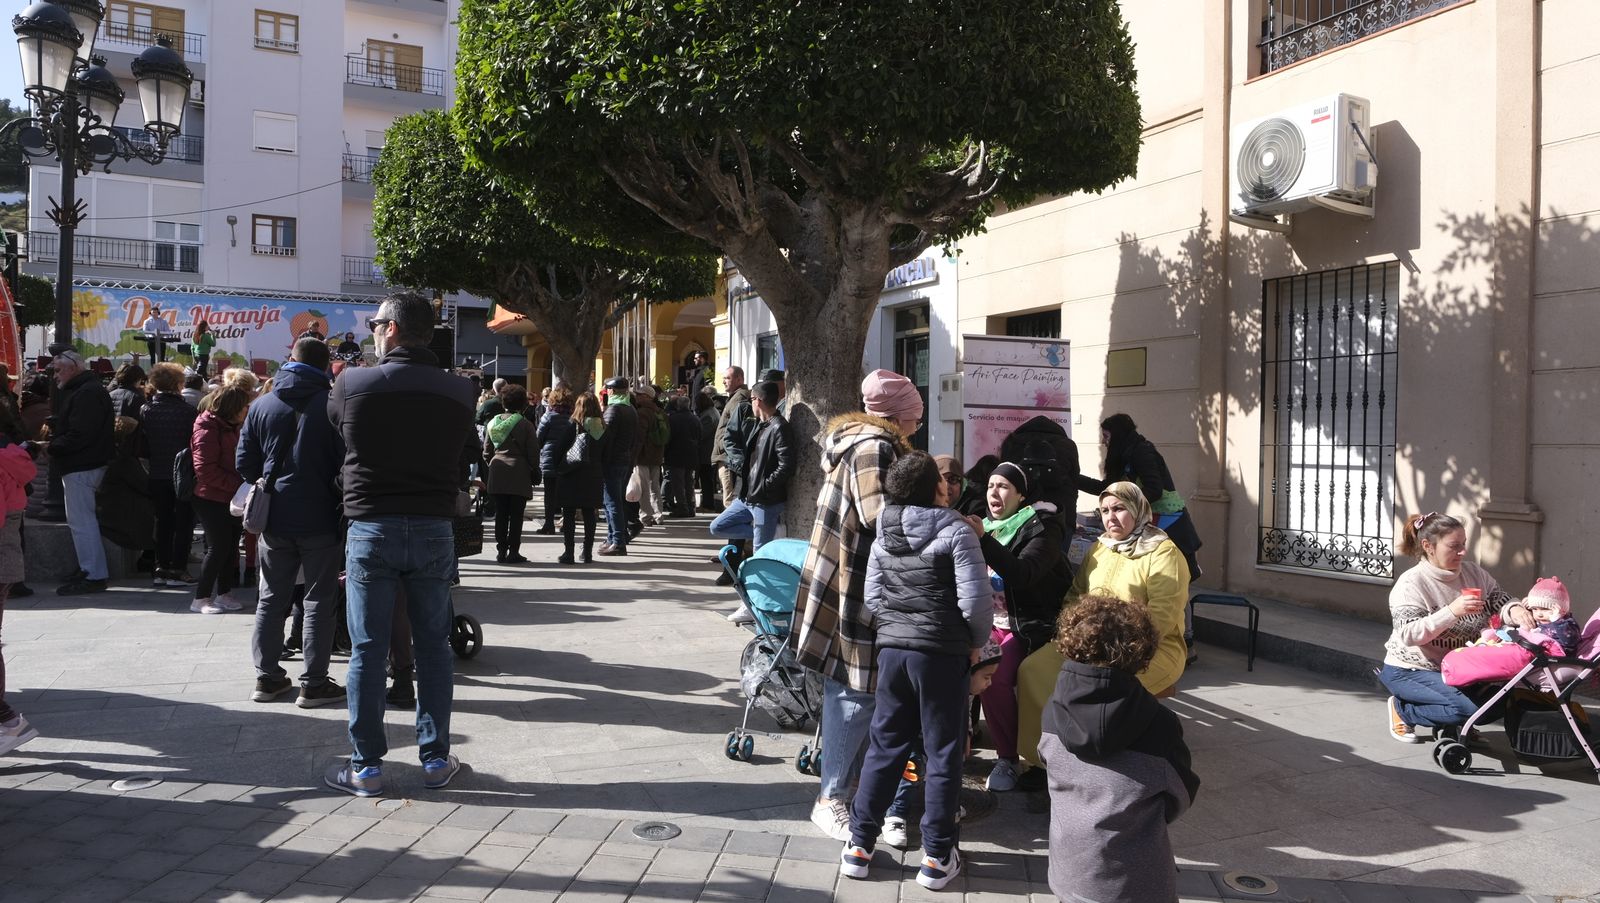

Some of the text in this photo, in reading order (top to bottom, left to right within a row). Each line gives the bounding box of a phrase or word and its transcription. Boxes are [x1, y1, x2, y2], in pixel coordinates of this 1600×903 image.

[190, 305, 281, 330] Naranja
[992, 367, 1019, 383] Face
[1021, 368, 1065, 390] Painting
[968, 413, 995, 421] Servicio
[337, 769, 348, 784] N
